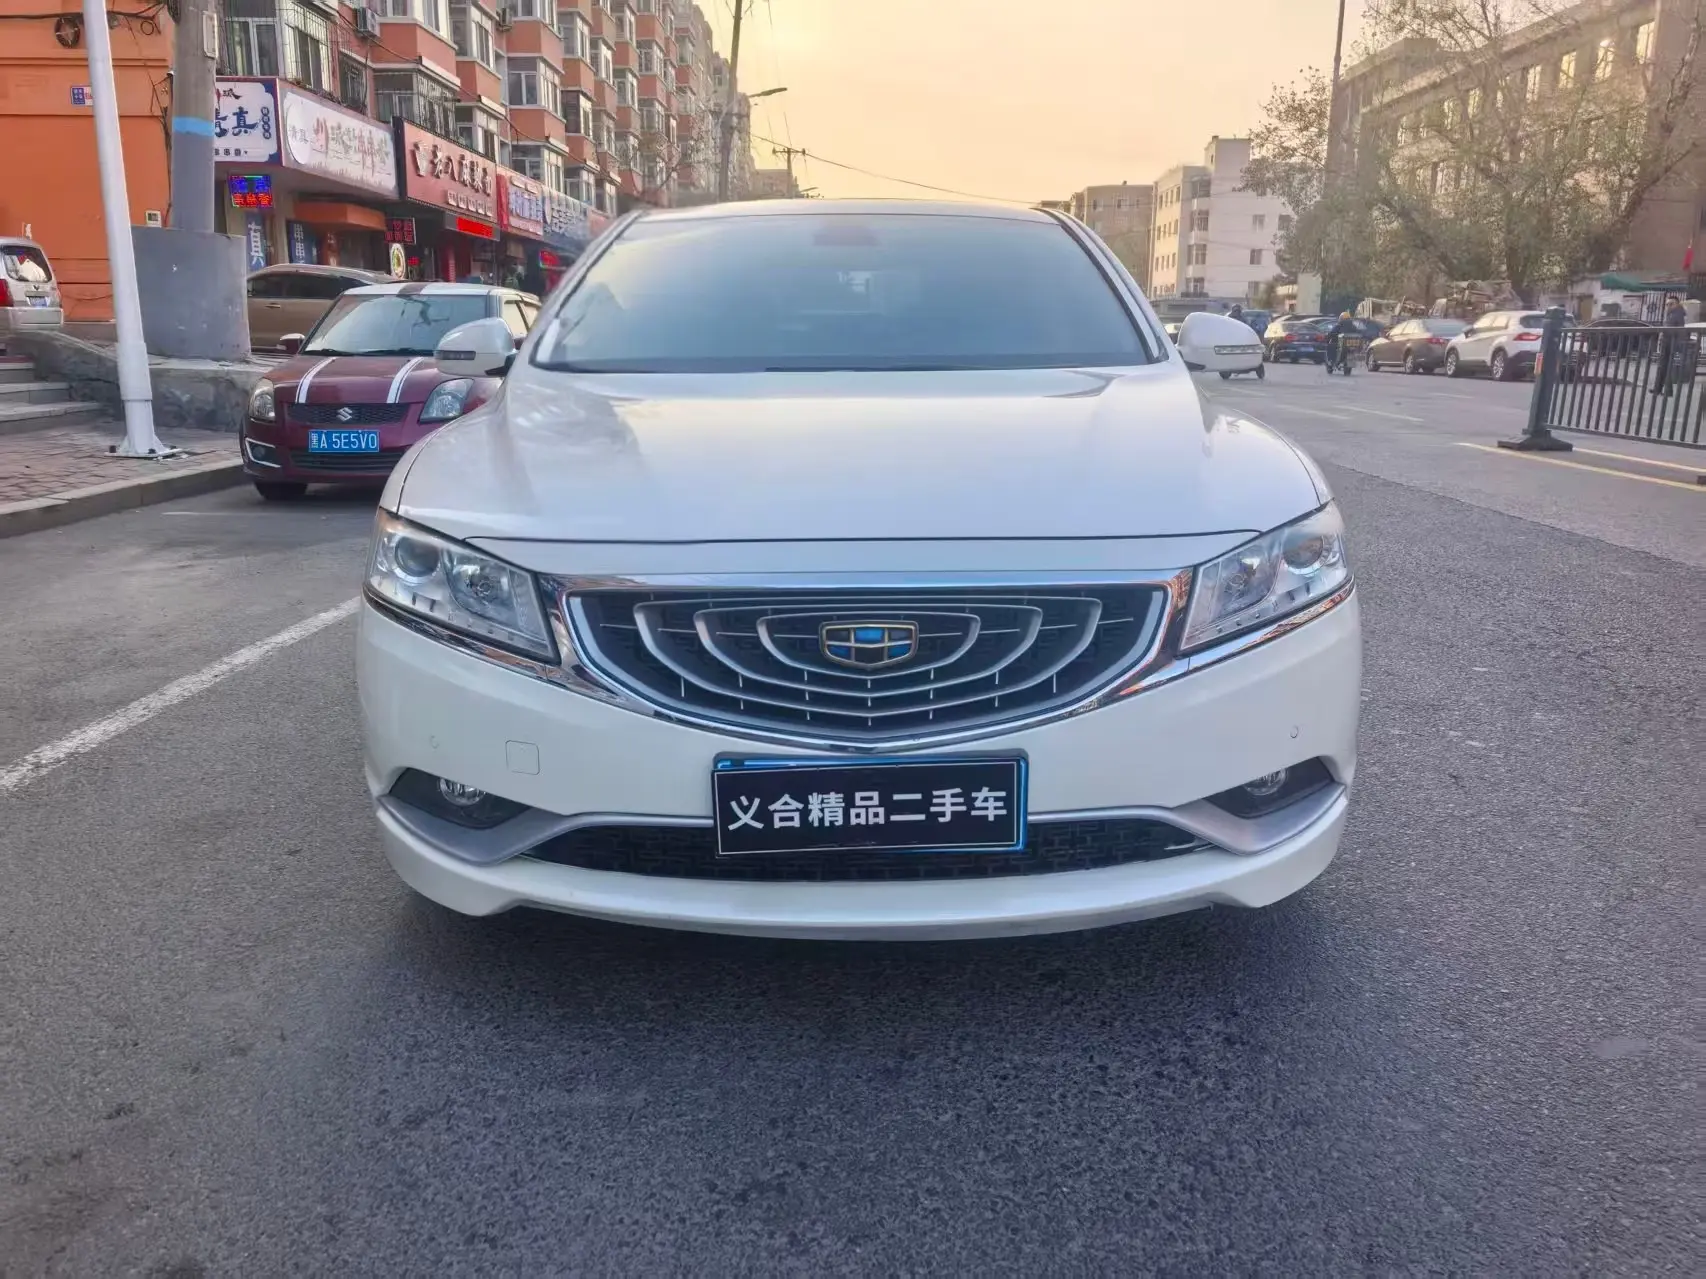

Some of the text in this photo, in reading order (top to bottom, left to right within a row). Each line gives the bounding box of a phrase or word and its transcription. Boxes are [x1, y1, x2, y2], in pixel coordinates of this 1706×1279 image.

[727, 786, 1008, 831] 义合精品二手车
